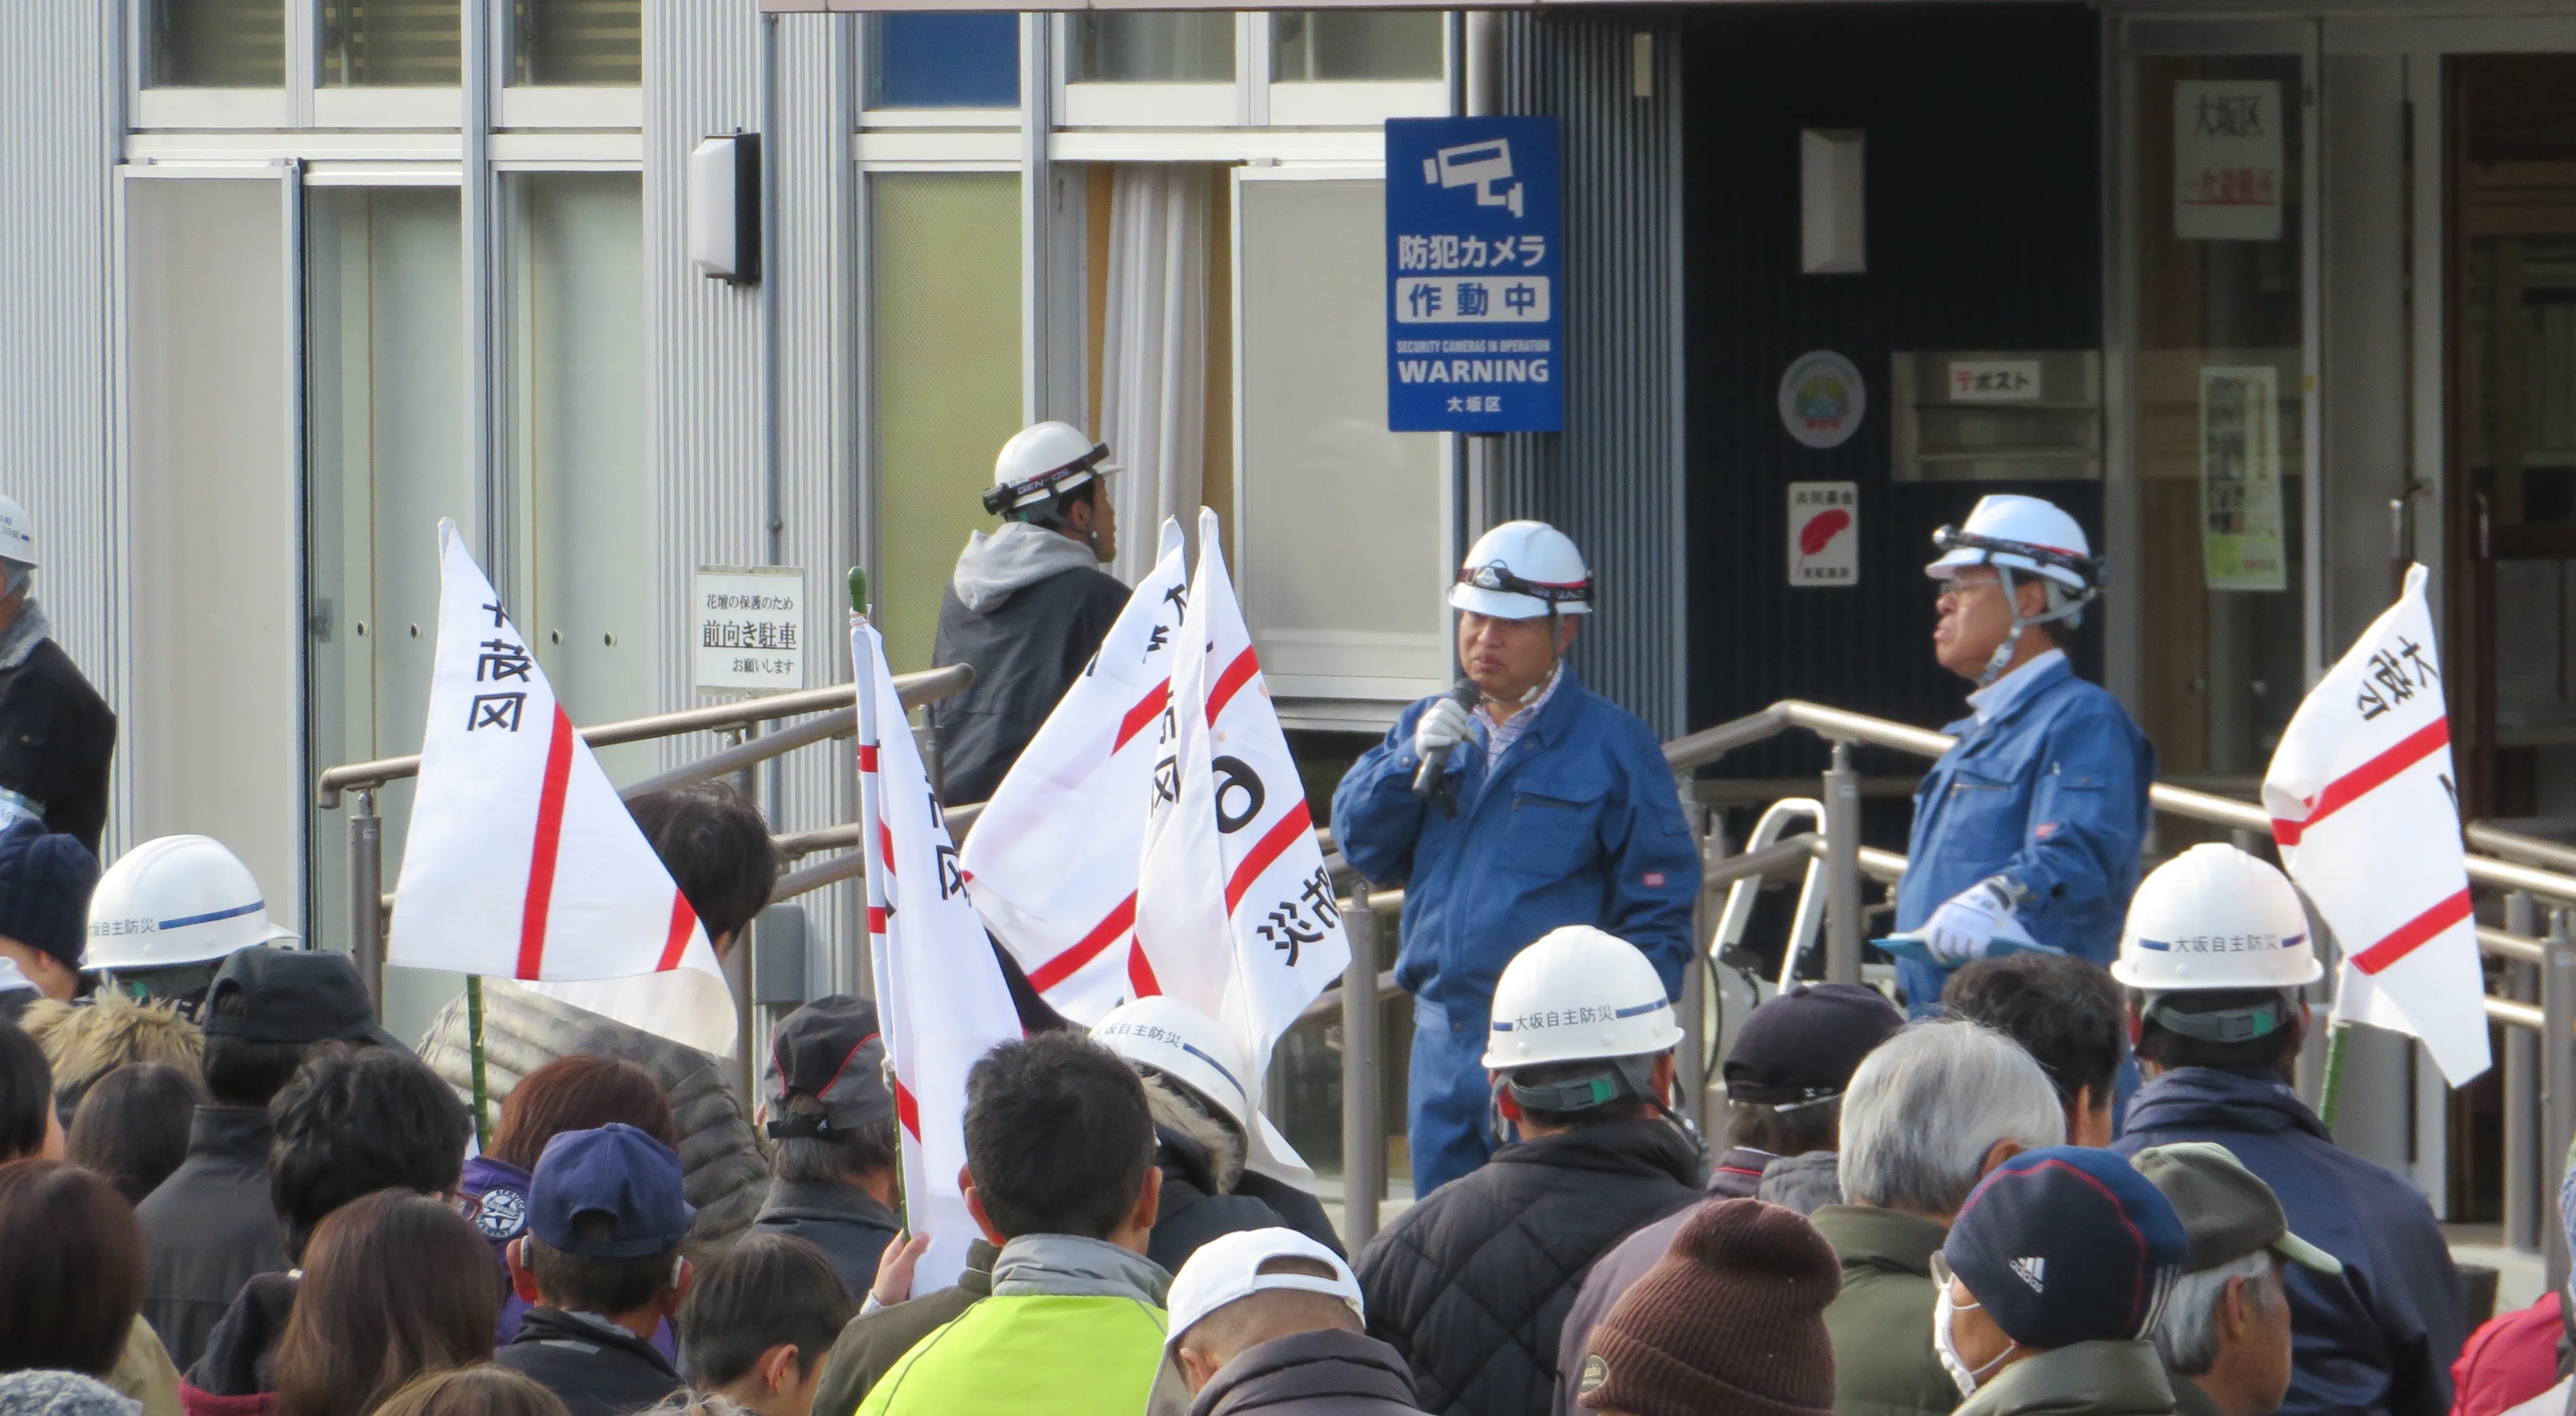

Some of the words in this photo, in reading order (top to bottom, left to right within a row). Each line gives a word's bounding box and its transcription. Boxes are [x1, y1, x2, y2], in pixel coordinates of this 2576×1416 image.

[1398, 235, 1545, 270] 防犯カメラ
[1409, 283, 1536, 317] 作動中
[1397, 340, 1439, 353] SECURITY
[1443, 340, 1485, 353] CAMERAS
[1488, 340, 1497, 352] IN
[1500, 339, 1550, 352] OPERATION
[1398, 359, 1548, 383] WARNING
[1447, 396, 1501, 412] 大坂区
[1018, 469, 1071, 494] GENOS
[706, 593, 793, 610] 花壇の保護のため
[703, 619, 796, 649] 前向き駐車
[733, 657, 795, 675] お願いします
[2174, 934, 2279, 953] 大坂自主防災
[1515, 1005, 1614, 1031] 大坂自主防災
